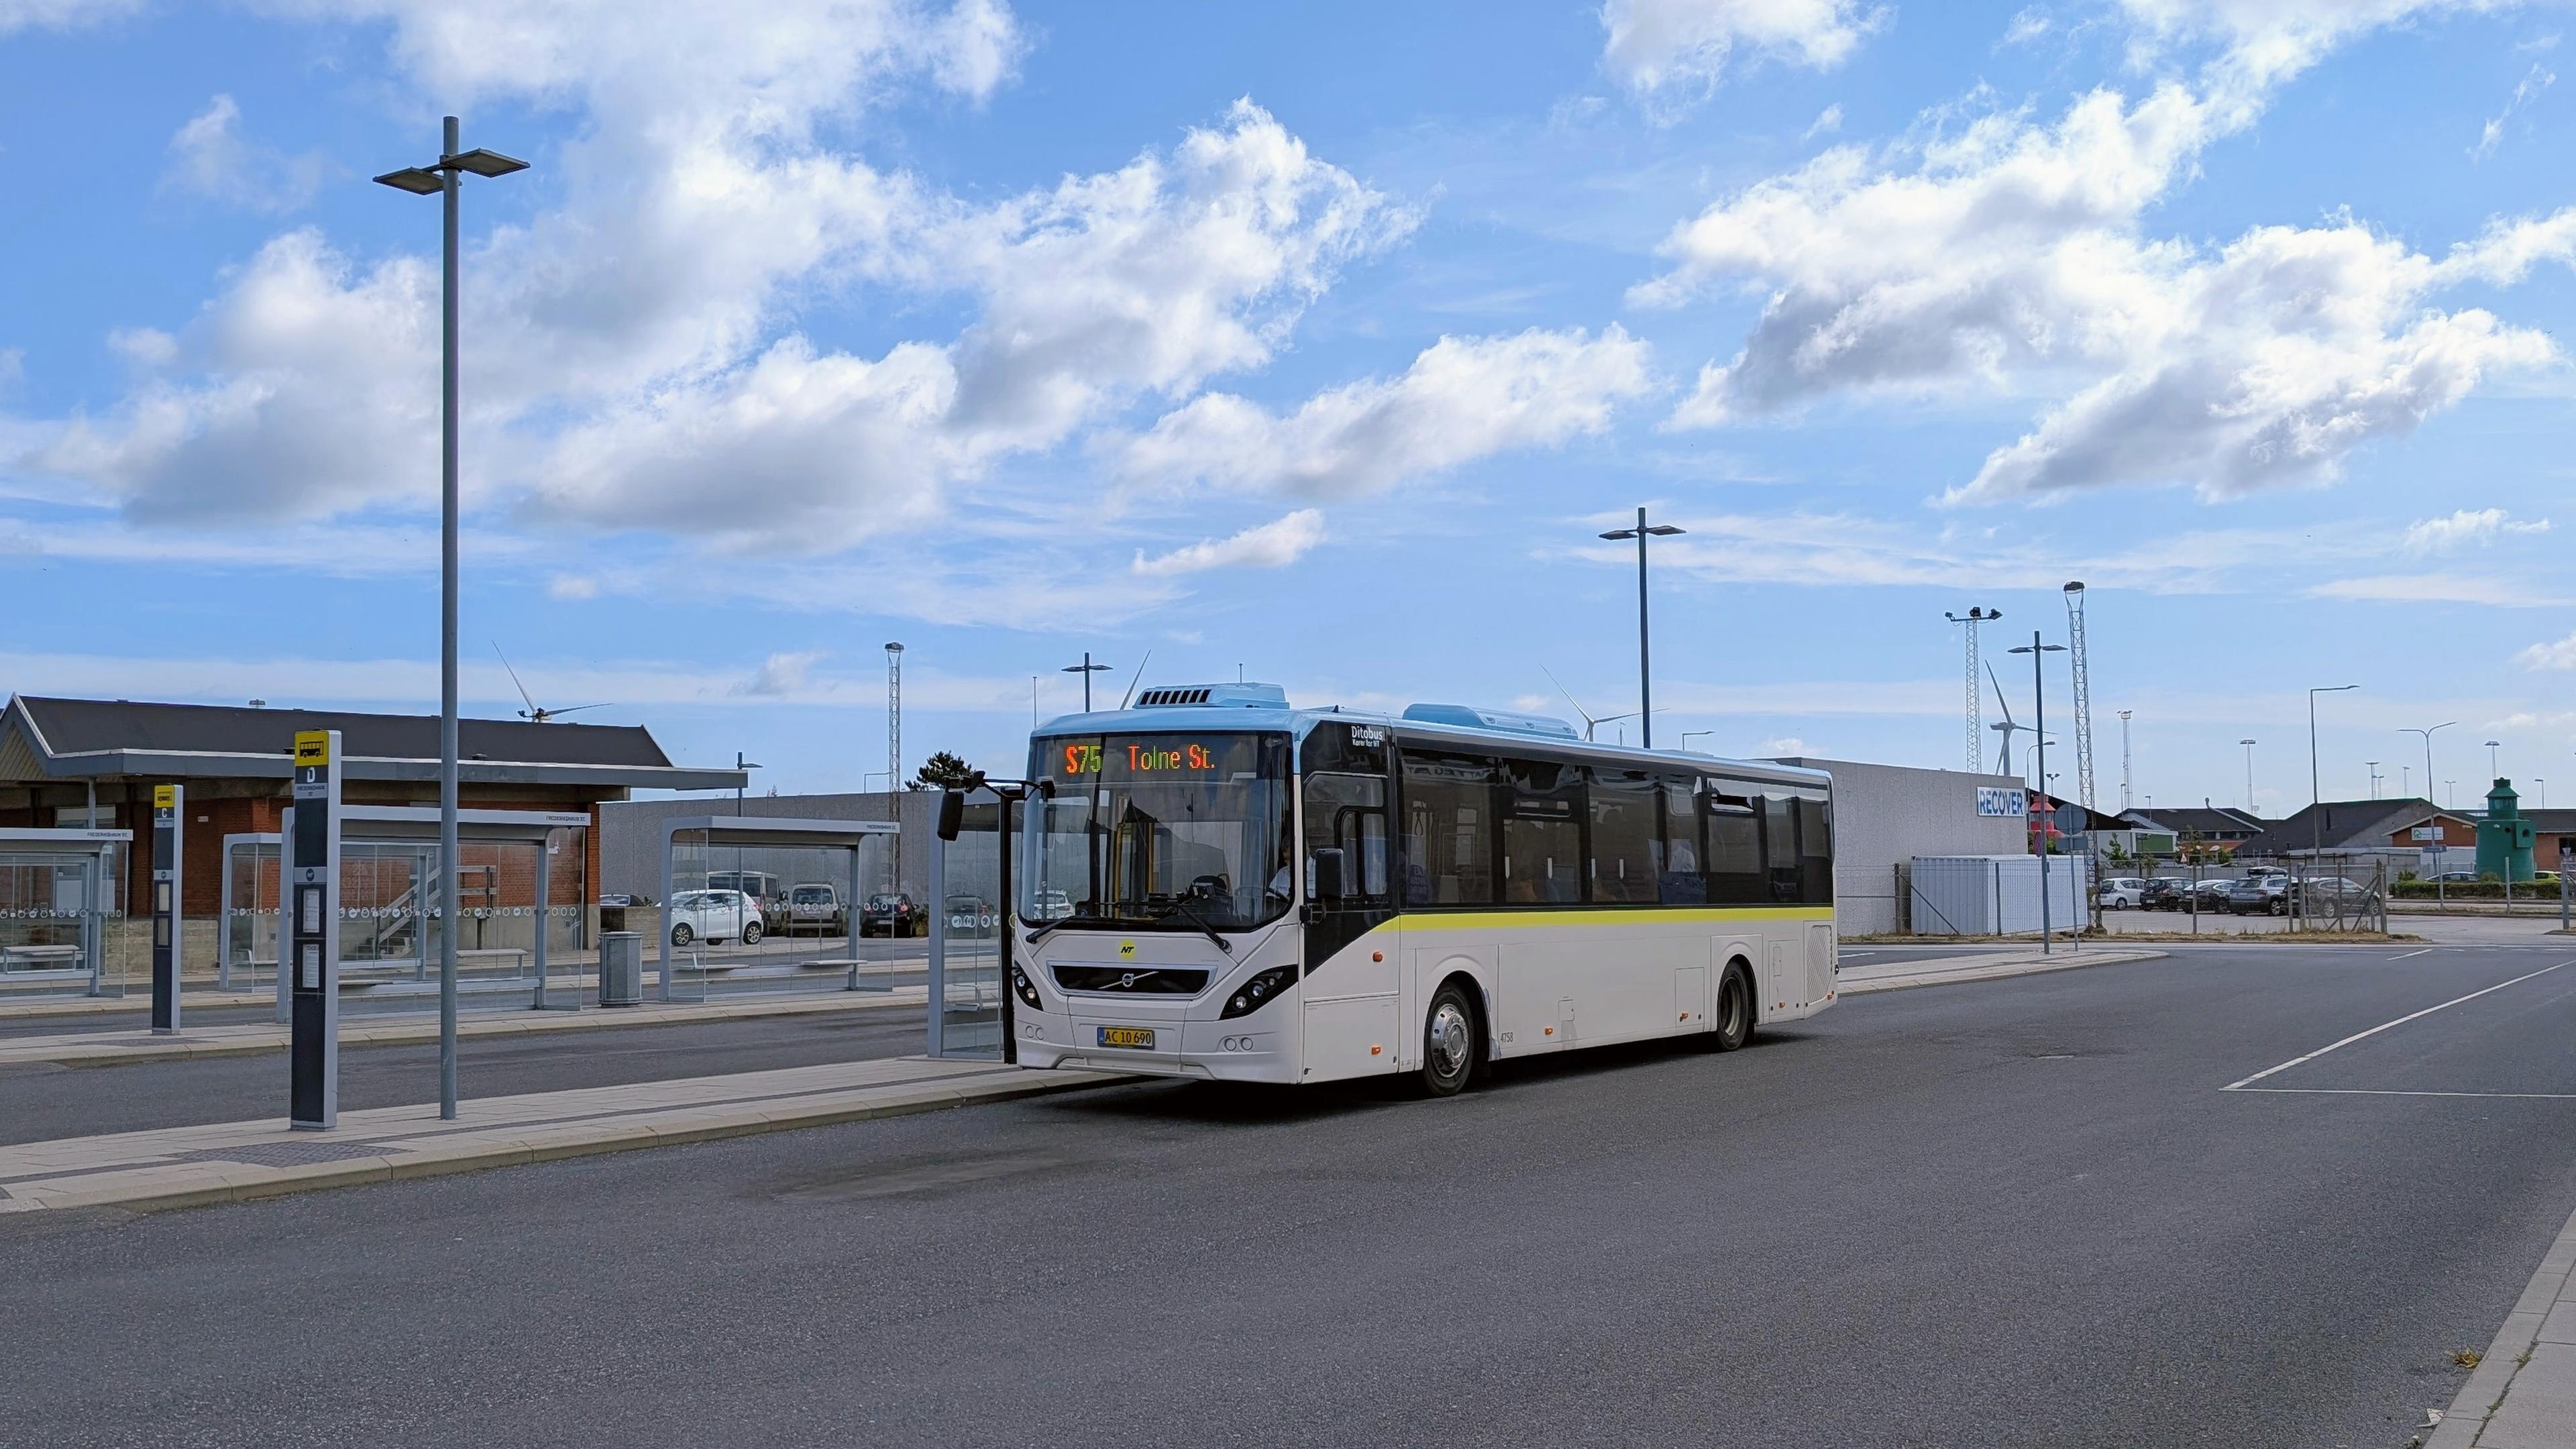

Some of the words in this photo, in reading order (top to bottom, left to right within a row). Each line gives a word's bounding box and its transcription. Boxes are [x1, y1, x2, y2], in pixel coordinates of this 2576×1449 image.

[1351, 725, 1383, 741] Ditobus
[1066, 745, 1102, 773] S75
[1128, 745, 1181, 771] Tolne
[1189, 743, 1216, 769] St.
[307, 766, 315, 783] D
[1979, 789, 2024, 815] RECOVER
[162, 808, 168, 818] C
[1120, 945, 1134, 953] NT
[1105, 1031, 1118, 1042] AC
[1120, 1032, 1132, 1043] 10
[1134, 1032, 1151, 1044] 690
[1500, 1032, 1513, 1042] 4758
